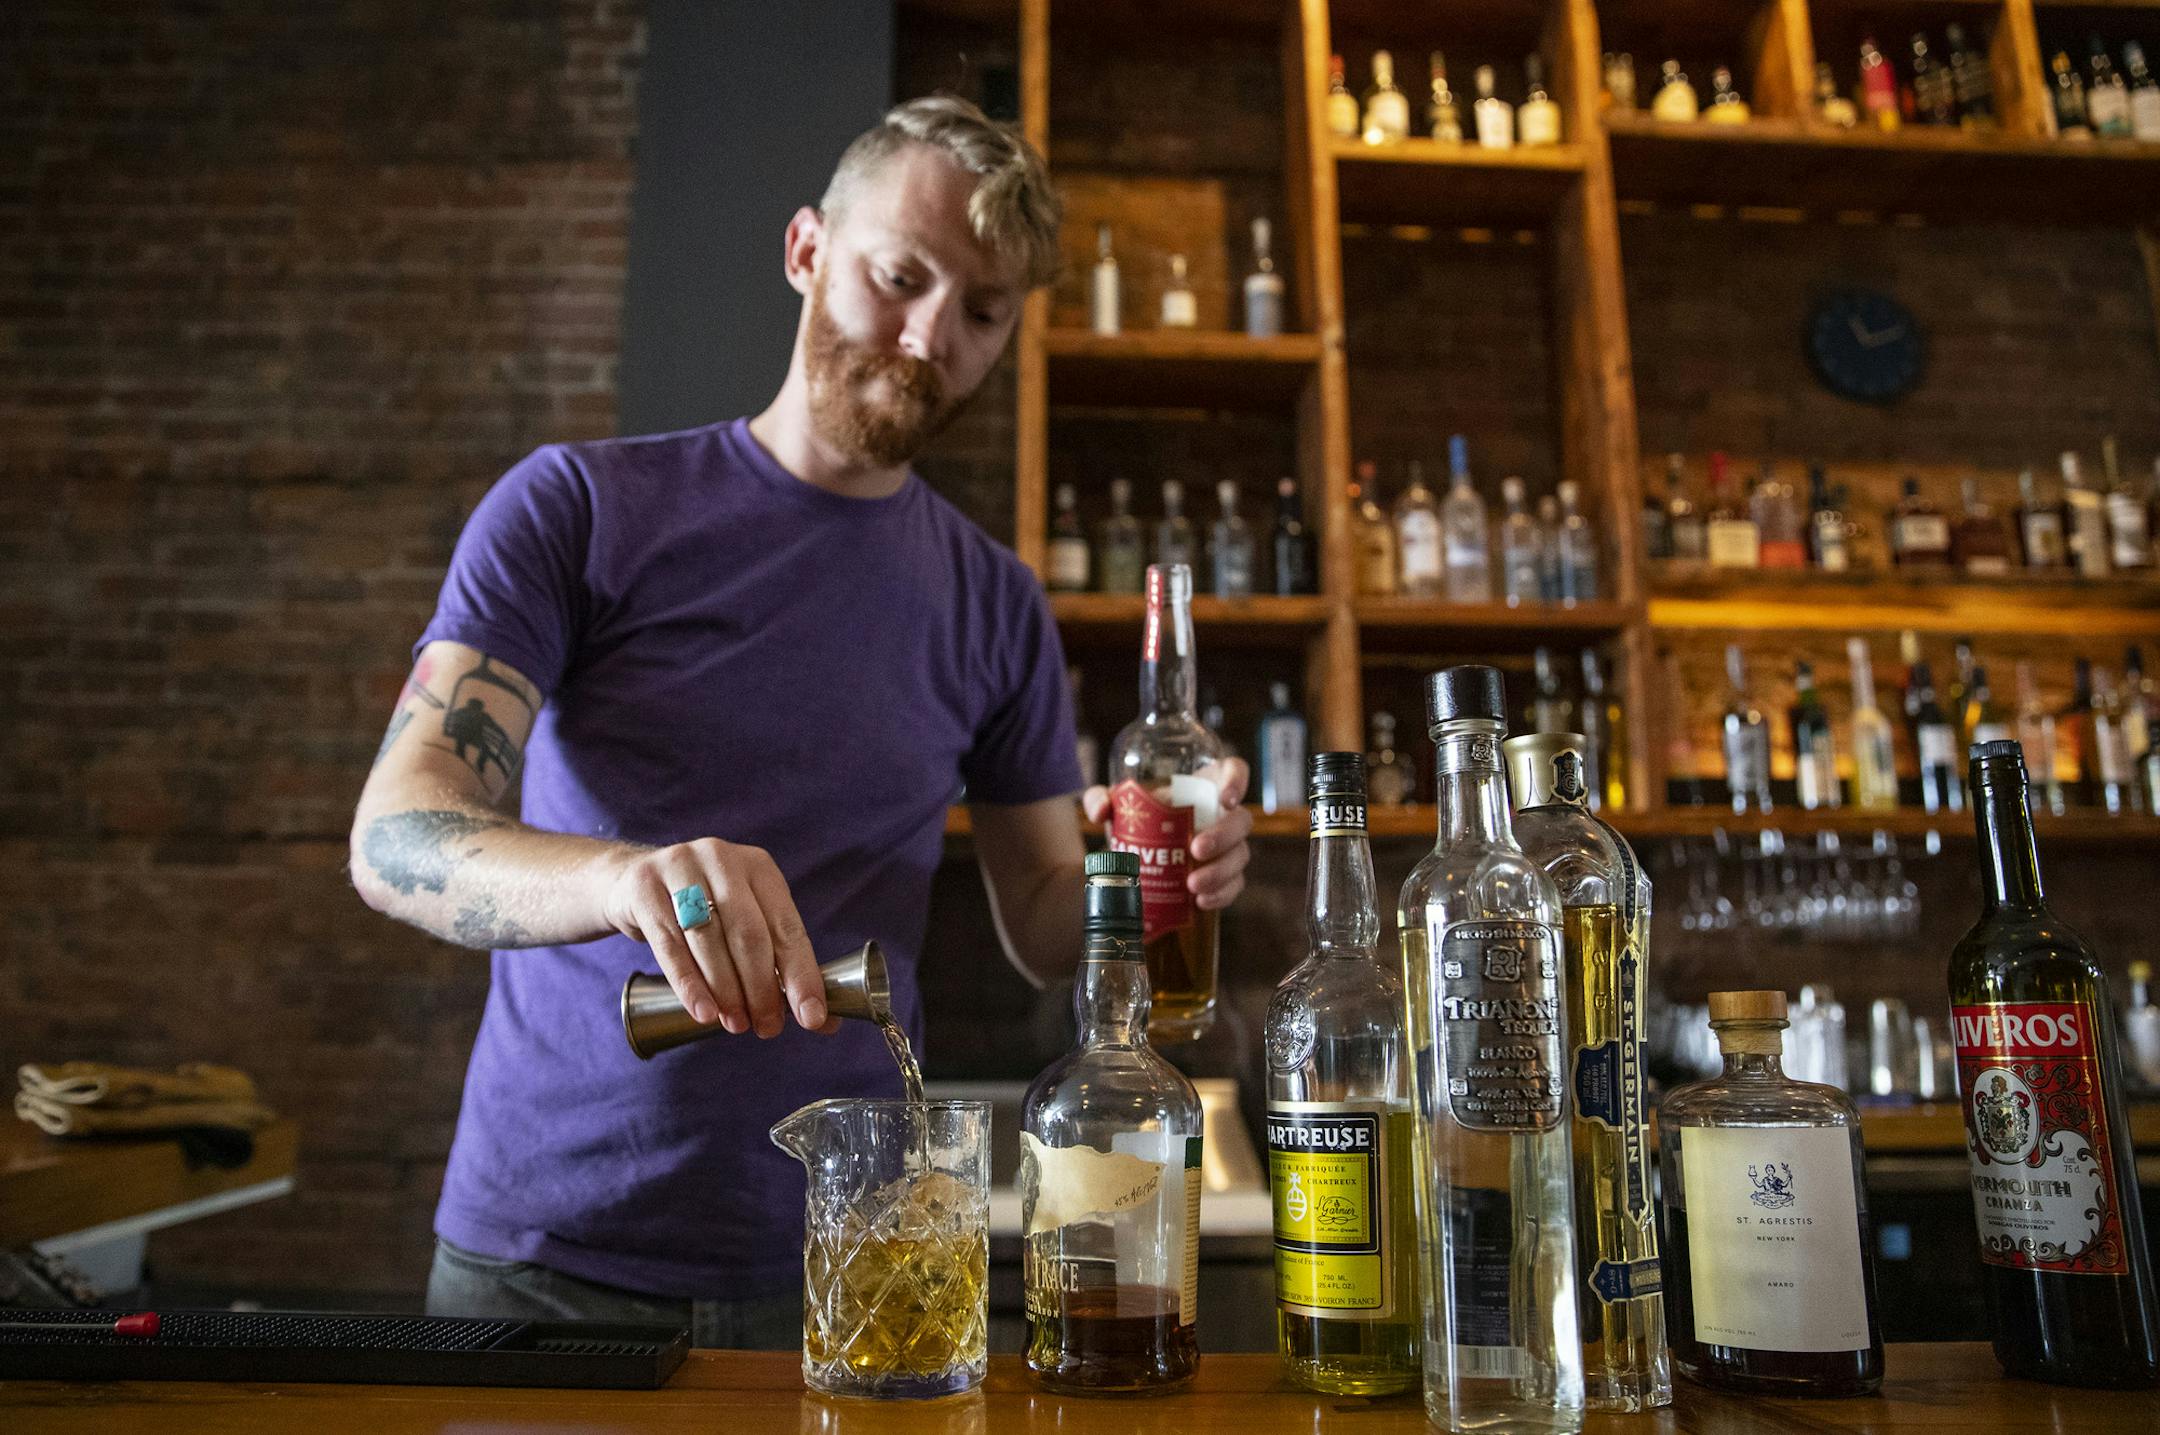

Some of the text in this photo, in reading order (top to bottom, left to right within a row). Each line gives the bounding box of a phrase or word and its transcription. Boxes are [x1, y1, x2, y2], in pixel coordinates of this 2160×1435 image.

[1480, 1045, 1537, 1060] BLANCO
[1623, 1000, 1639, 1163] ST-GERMAIN
[1307, 1178, 1357, 1186] CHARTREUX
[1971, 1174, 2072, 1199] VERMOUTH
[1986, 1196, 2044, 1212] CRIANZA
[1736, 1216, 1813, 1225] ST. AGRESTIS
[1034, 1253, 1079, 1292] TRACE
